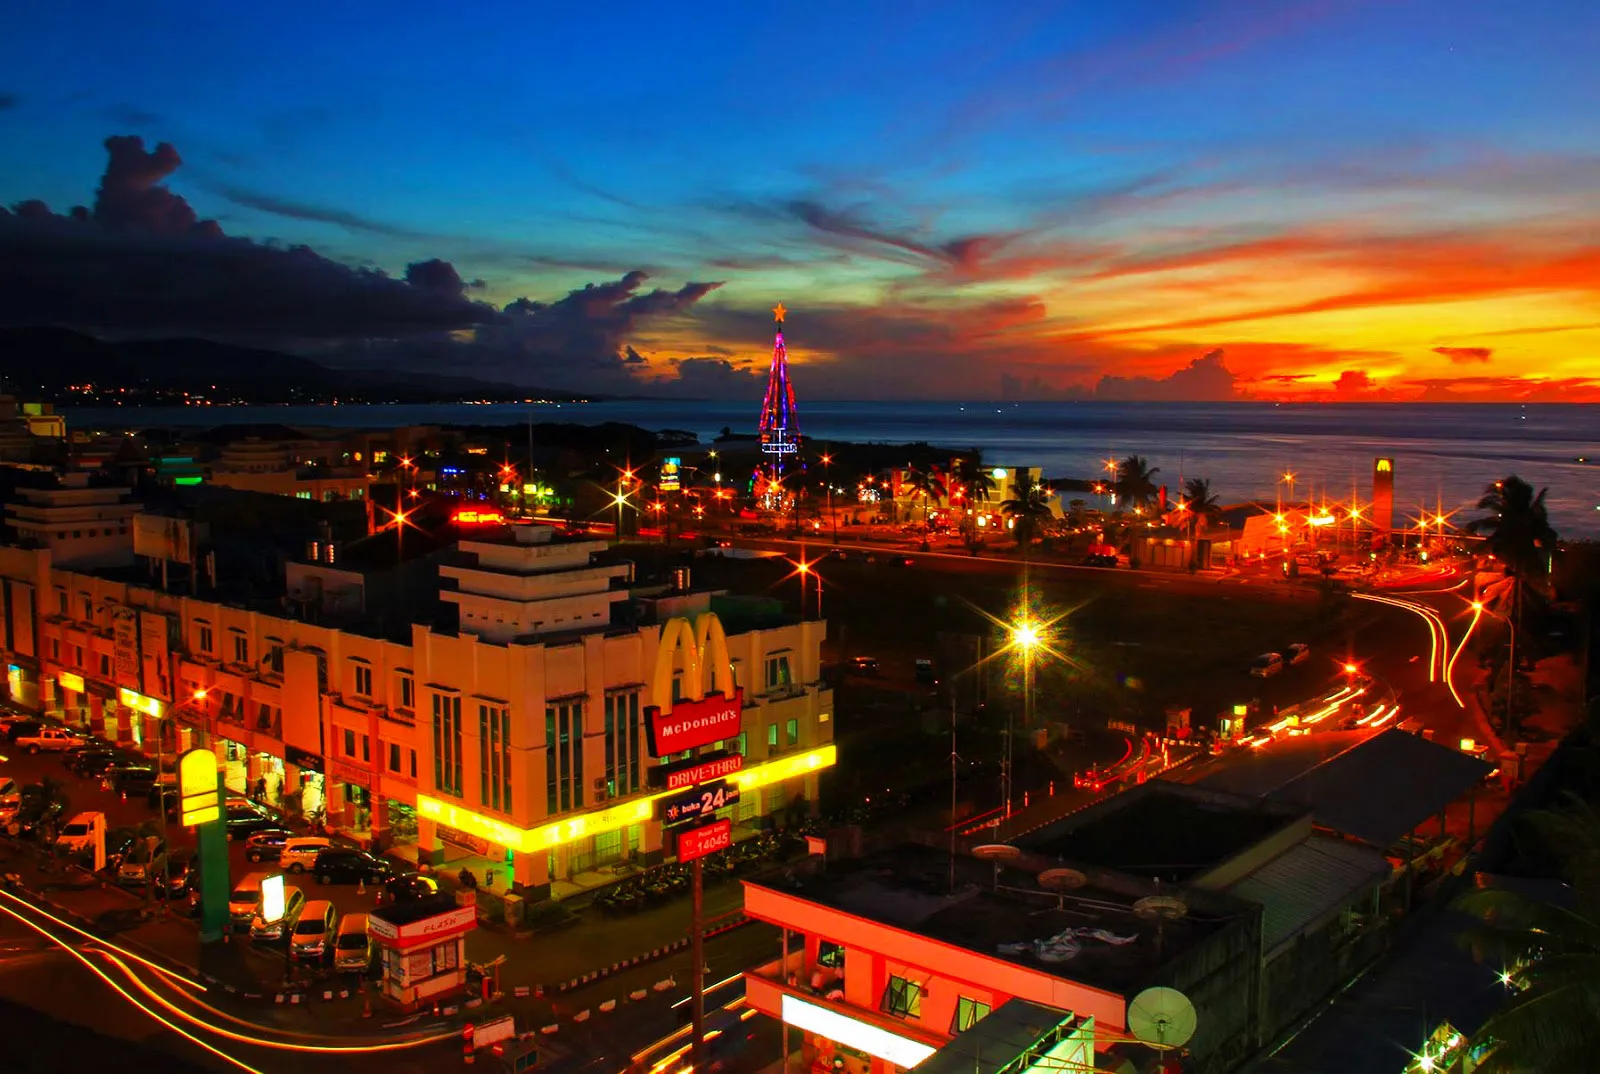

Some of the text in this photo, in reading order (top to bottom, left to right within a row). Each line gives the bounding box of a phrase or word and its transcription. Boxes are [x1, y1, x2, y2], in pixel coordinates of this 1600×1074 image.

[662, 710, 737, 737] McDonald's
[669, 757, 741, 789] DRIVE-THRU
[681, 802, 700, 814] buka
[701, 788, 725, 813] 24
[697, 832, 728, 853] 14045
